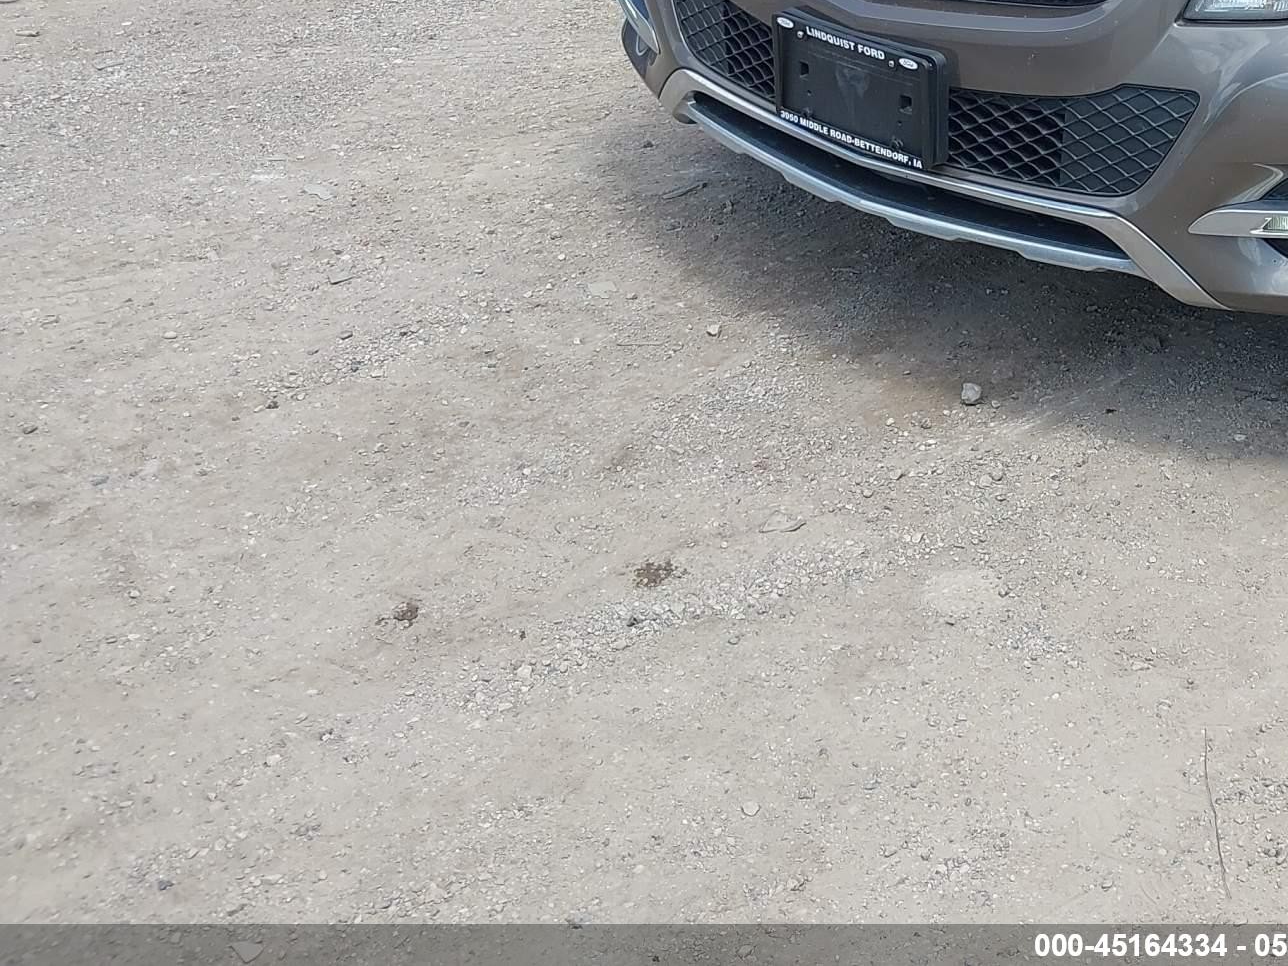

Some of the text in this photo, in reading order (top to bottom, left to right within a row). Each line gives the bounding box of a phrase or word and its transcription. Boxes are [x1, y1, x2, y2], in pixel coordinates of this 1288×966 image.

[806, 26, 886, 60] LINDQUIST FORD
[799, 117, 829, 135] MIDDLE
[913, 158, 923, 169] IA
